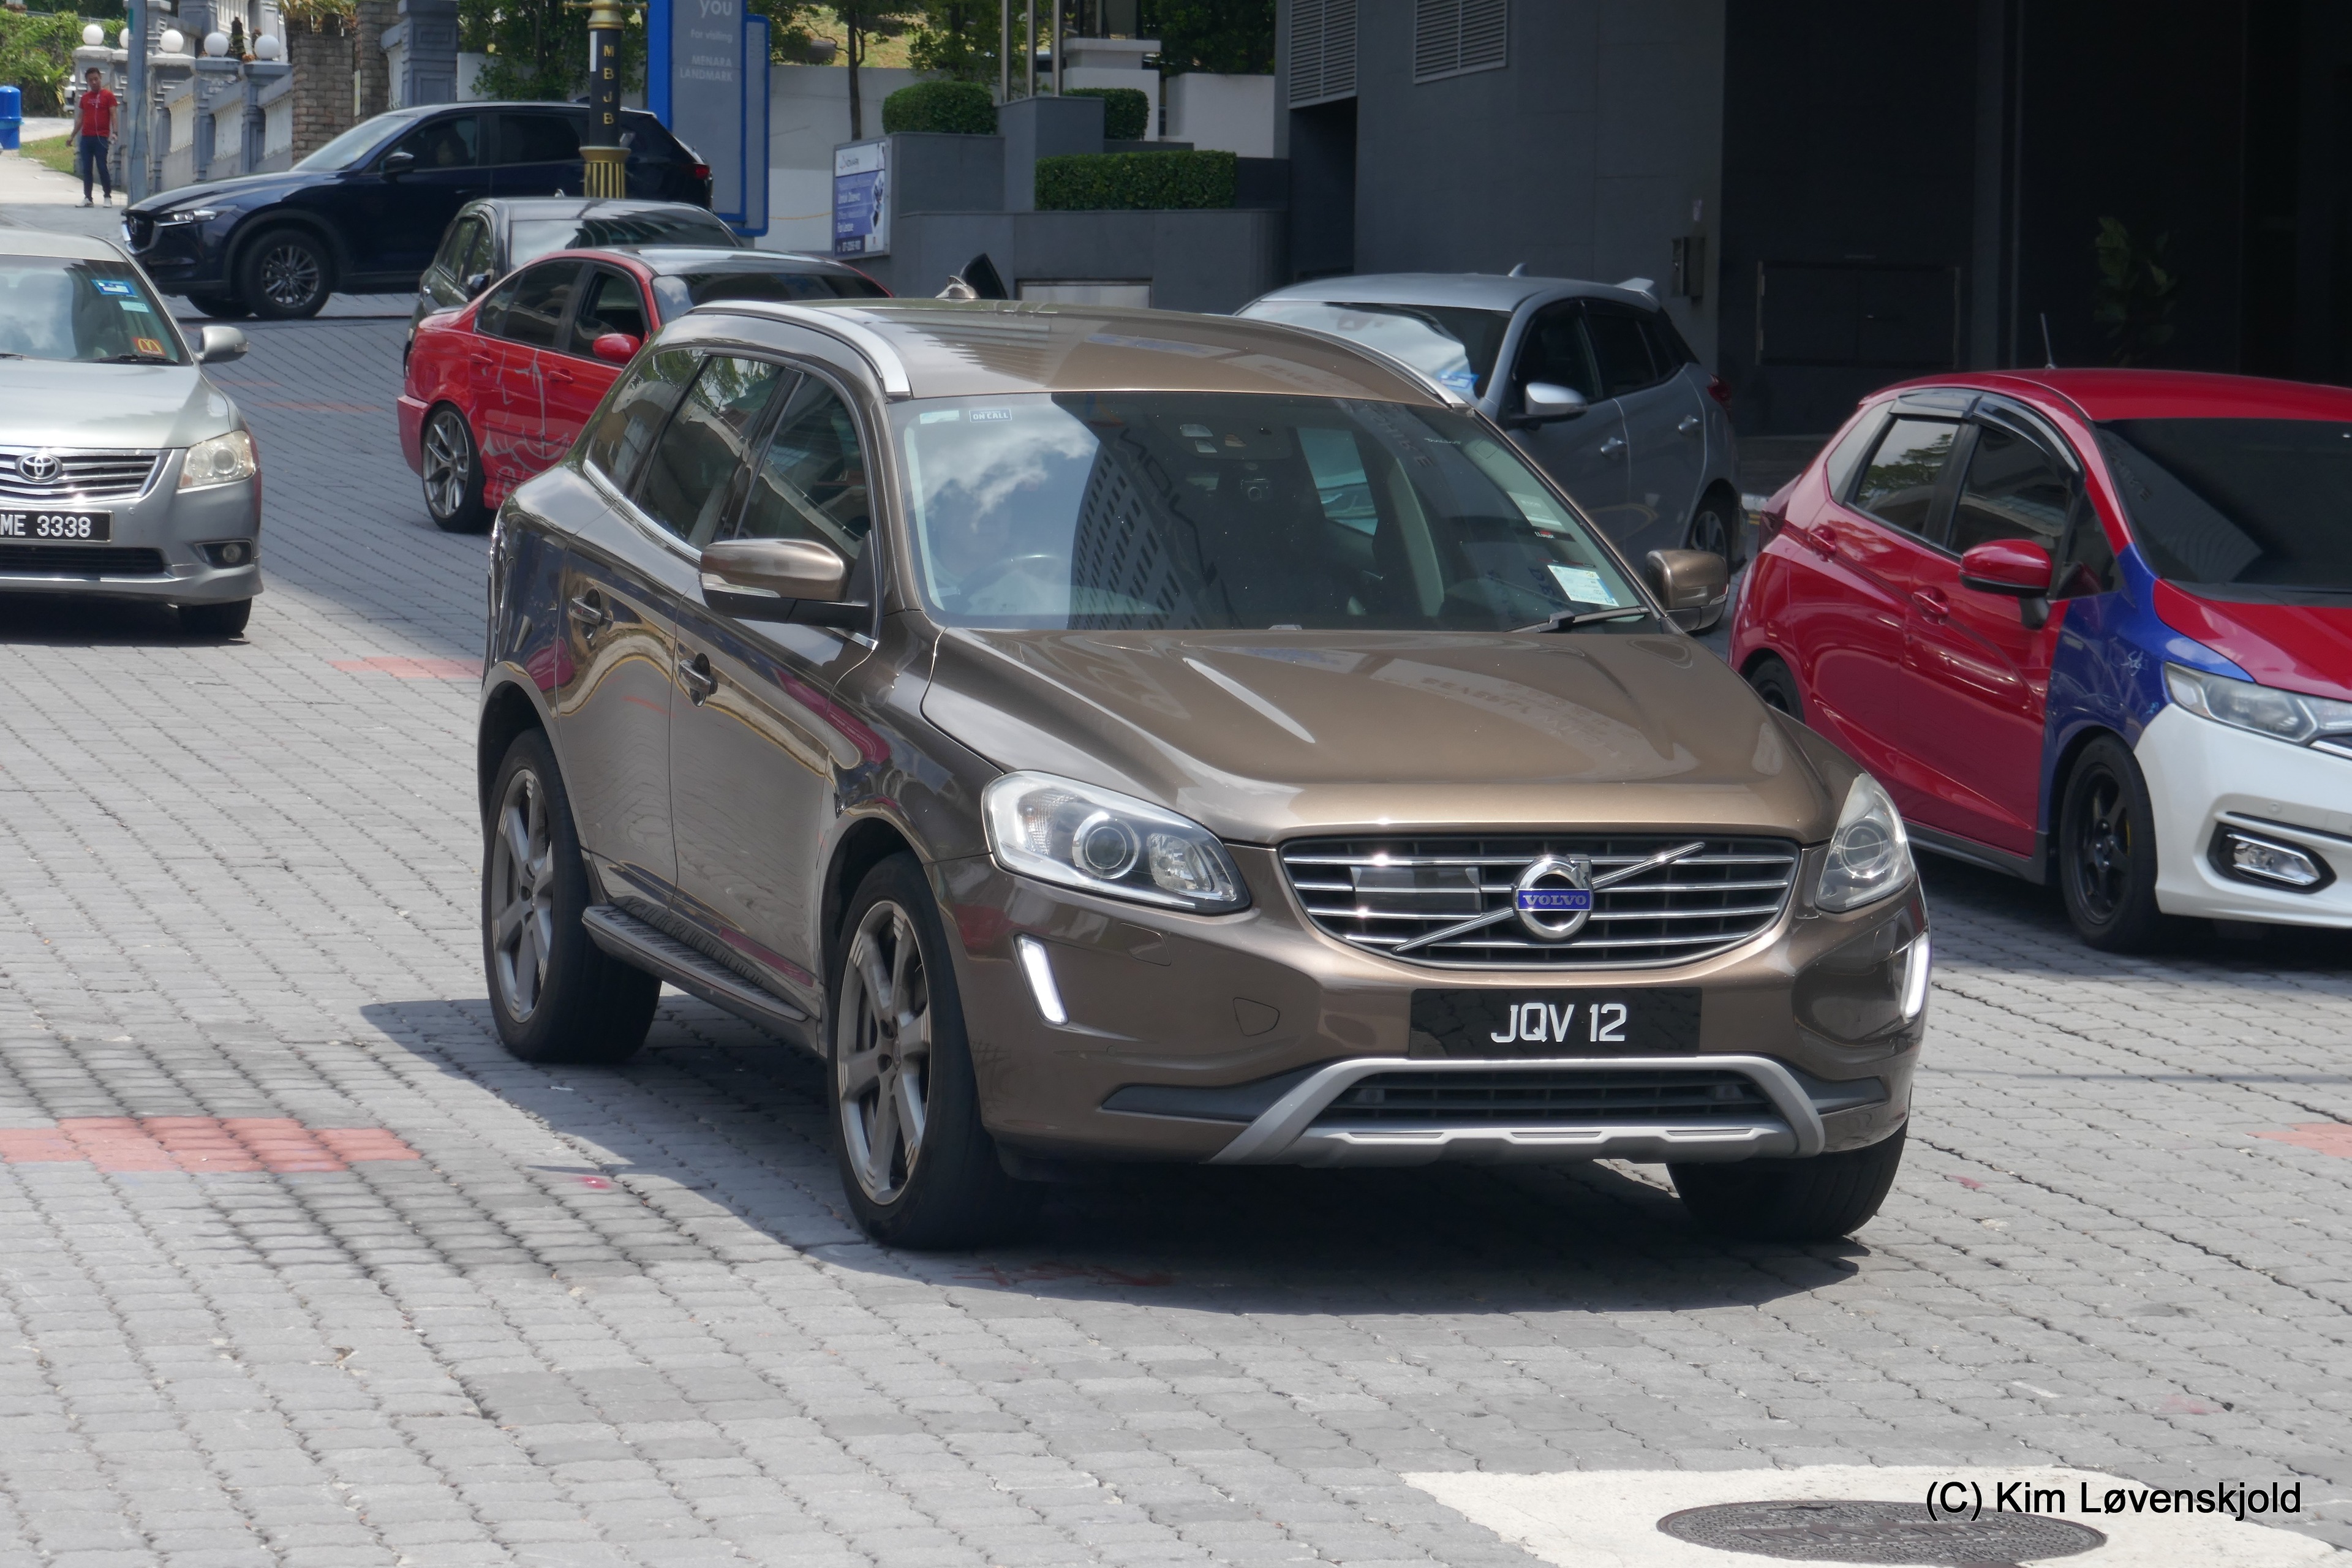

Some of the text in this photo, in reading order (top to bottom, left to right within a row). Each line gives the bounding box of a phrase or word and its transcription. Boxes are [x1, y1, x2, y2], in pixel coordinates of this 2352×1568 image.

[700, 0, 732, 18] you
[691, 29, 733, 43] For visiting
[692, 55, 733, 67] MENARA
[680, 67, 733, 82] LANDMARK
[603, 45, 614, 125] MBJB
[37, 515, 91, 538] 3338
[1523, 895, 1587, 905] VOLVO
[1491, 1002, 1627, 1043] JQV 12
